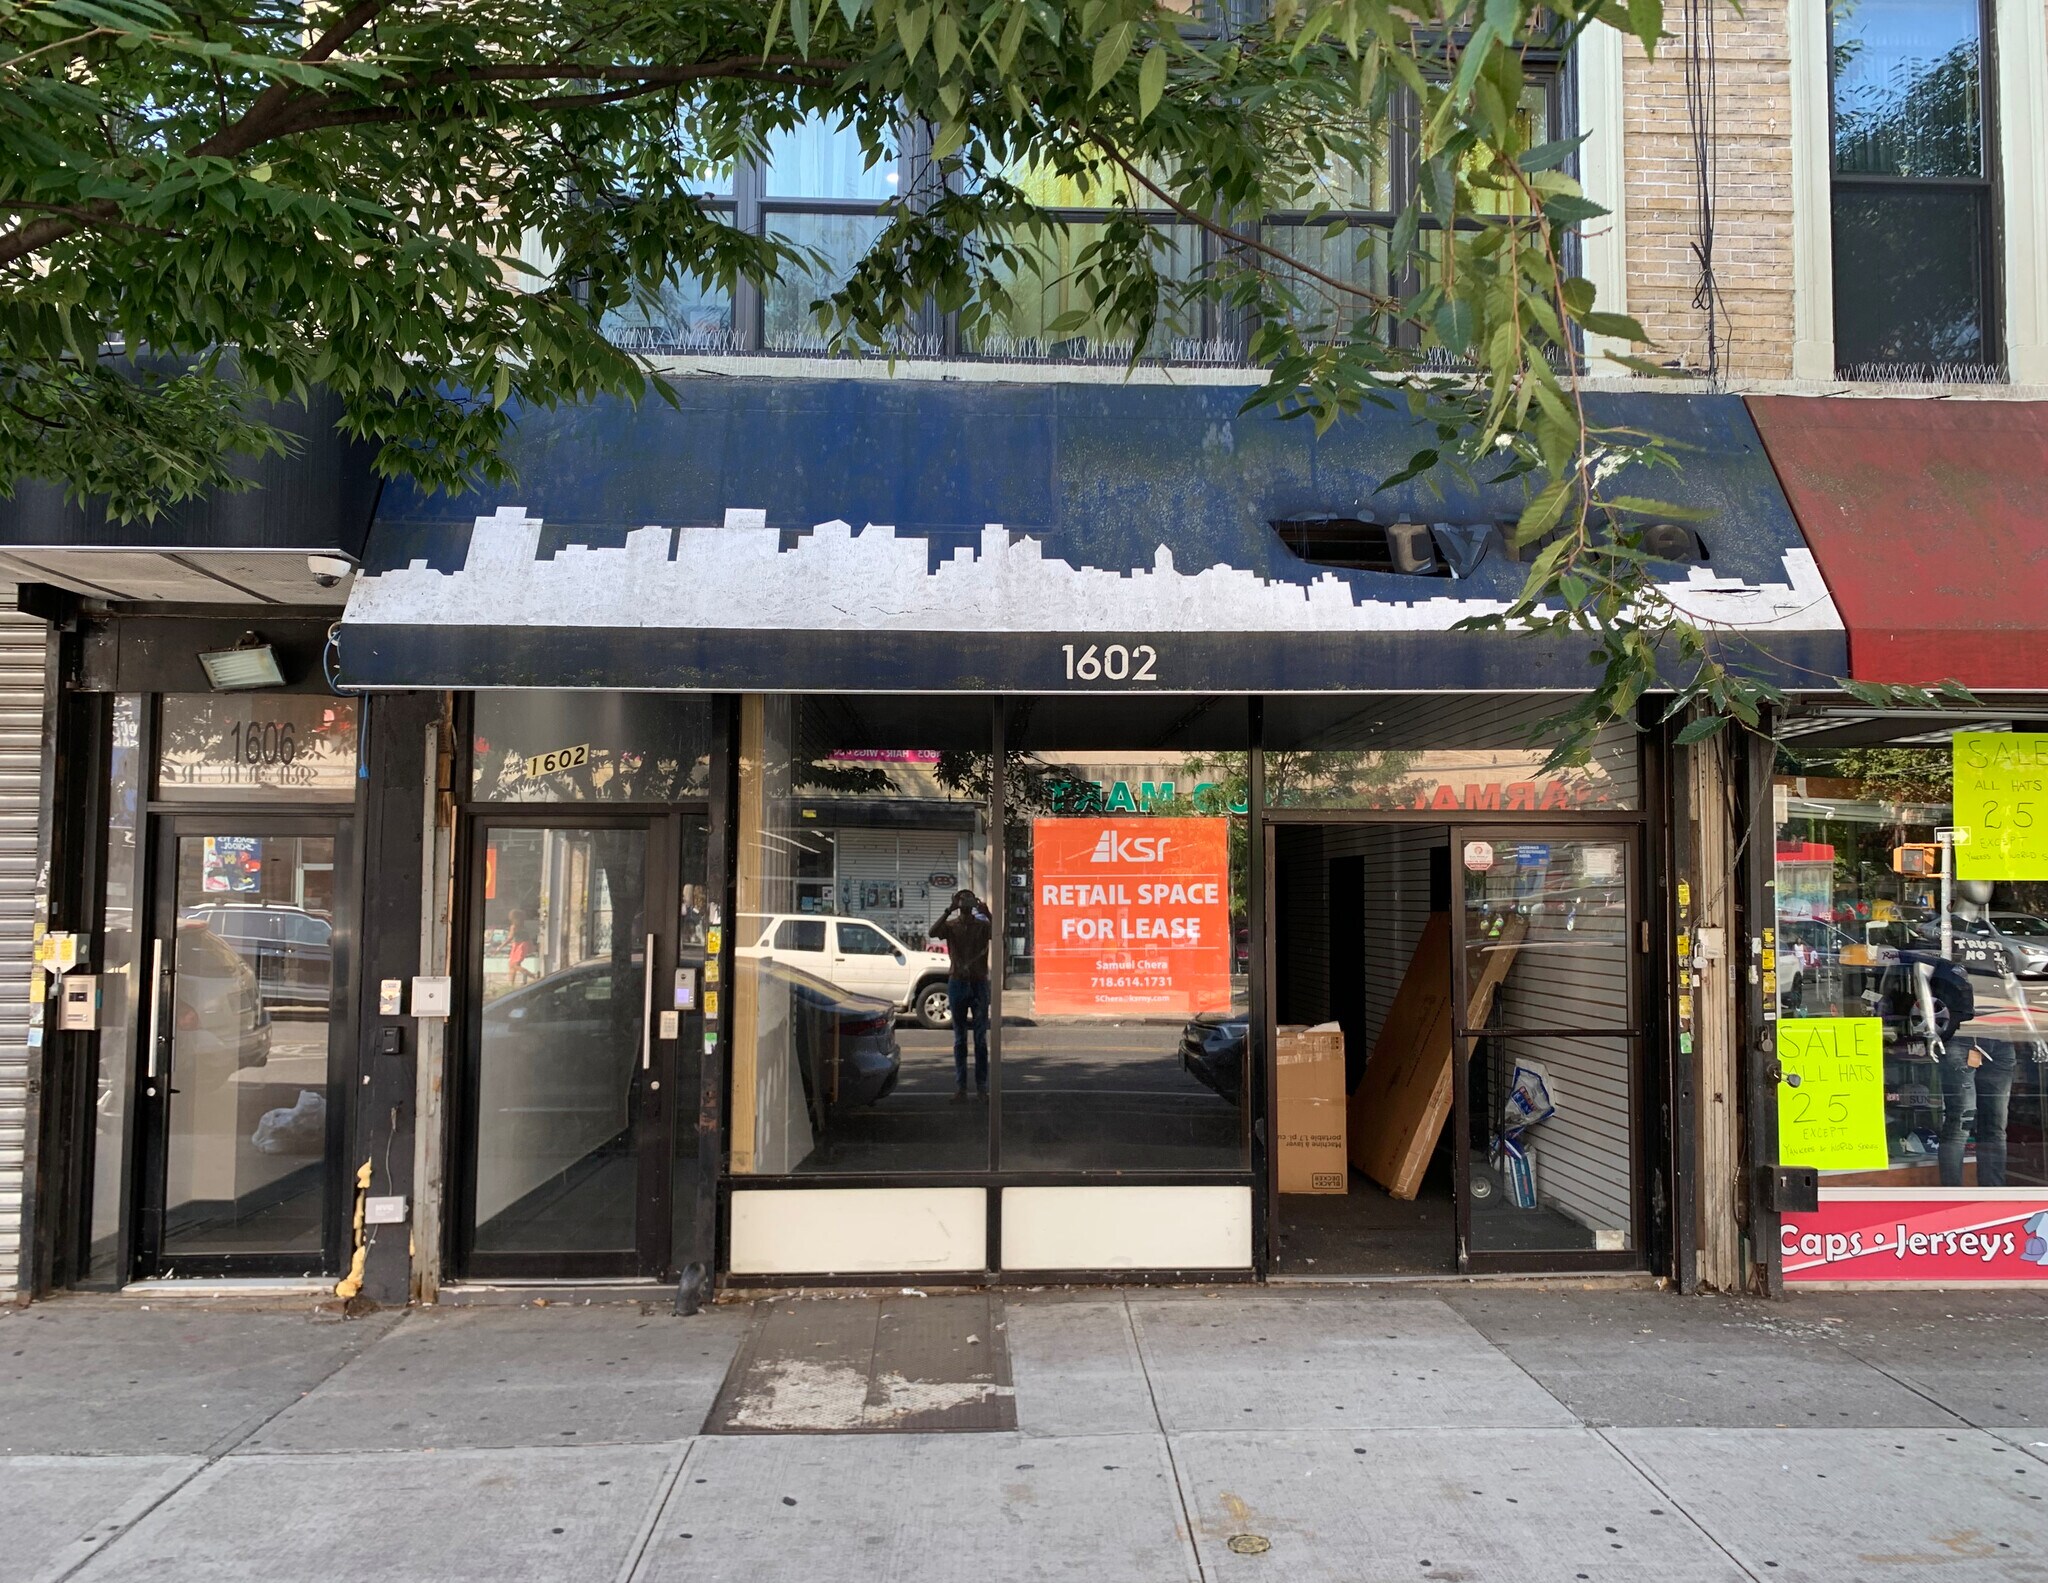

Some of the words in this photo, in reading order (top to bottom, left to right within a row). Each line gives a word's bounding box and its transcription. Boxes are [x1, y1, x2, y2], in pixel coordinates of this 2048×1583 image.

[1062, 644, 1157, 680] 1602
[231, 721, 295, 765] 1606
[1967, 739, 2048, 769] SALE
[532, 746, 585, 776] 1602
[1974, 780, 2000, 791] ALL
[2011, 779, 2043, 792] HATS
[1980, 836, 2029, 850] EXCEPT
[1042, 884, 1131, 905] RETAIL
[1137, 883, 1219, 905] SPACE
[1061, 918, 1114, 940] FOR
[1121, 917, 1201, 940] LEASE
[1954, 938, 2003, 951] TRUST
[1965, 950, 1986, 960] NO
[1096, 959, 1135, 970] Samuel
[1137, 959, 1168, 970] Chera
[1091, 976, 1172, 987] 718.614.1731
[1779, 1023, 1869, 1058] SALE
[1838, 1063, 1875, 1082] HATS
[1792, 1092, 1851, 1123] 25
[1803, 1127, 1848, 1140] EXCEPT
[1781, 1224, 1863, 1262] Caps
[1895, 1223, 2015, 1262] Jerseys
